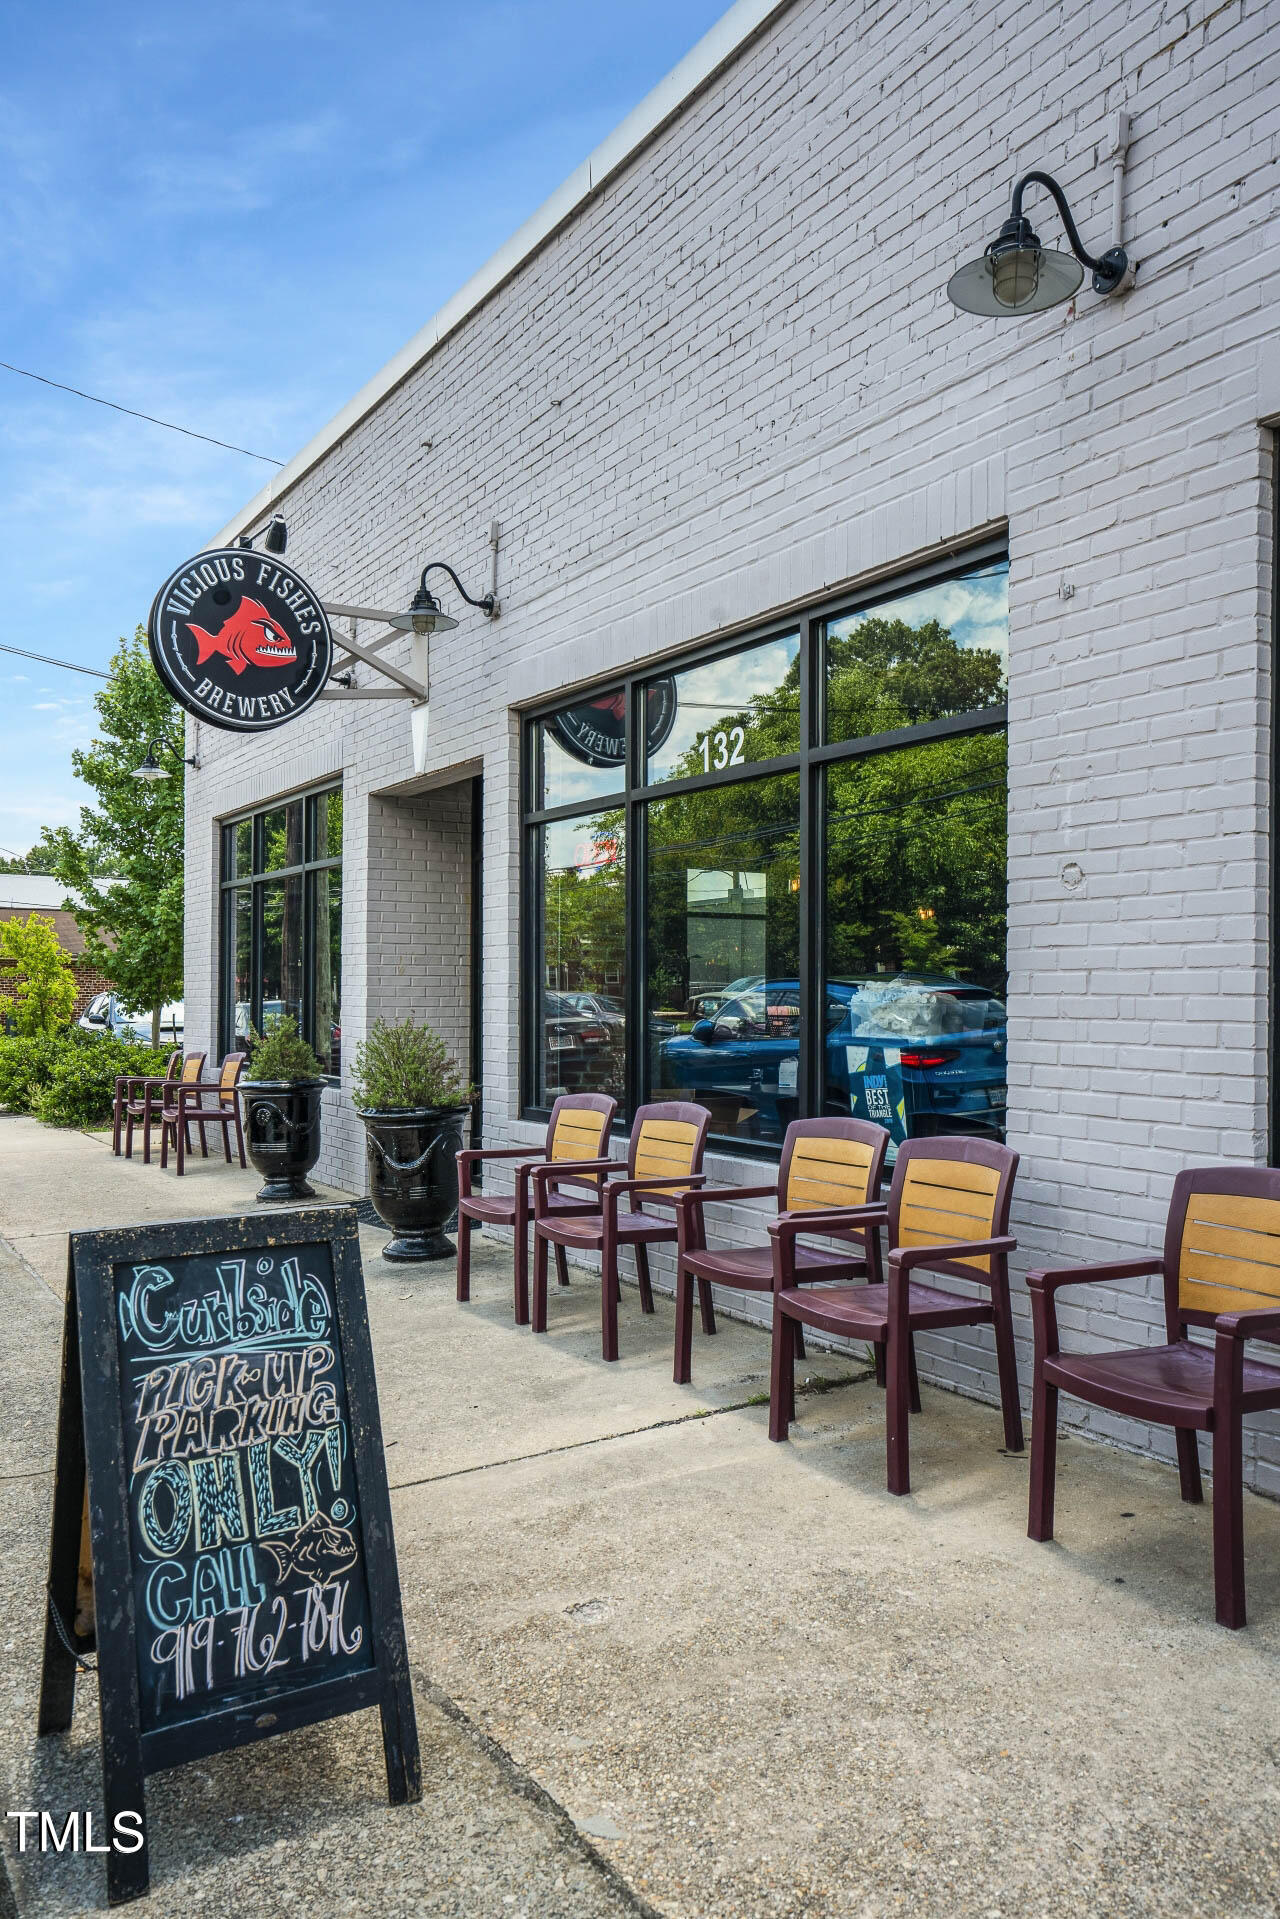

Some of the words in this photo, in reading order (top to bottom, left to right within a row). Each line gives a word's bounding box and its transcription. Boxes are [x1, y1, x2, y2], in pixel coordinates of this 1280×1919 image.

[167, 557, 245, 617] VICIOUS
[256, 563, 321, 635] FISHES
[194, 677, 295, 718] BREWERY
[699, 726, 745, 773] 132
[865, 1089, 889, 1106] BEST
[868, 1108, 893, 1118] TRIANGLE
[119, 1257, 331, 1350] Curbside
[133, 1382, 340, 1473] PARKING
[138, 1425, 350, 1558] ONLY!
